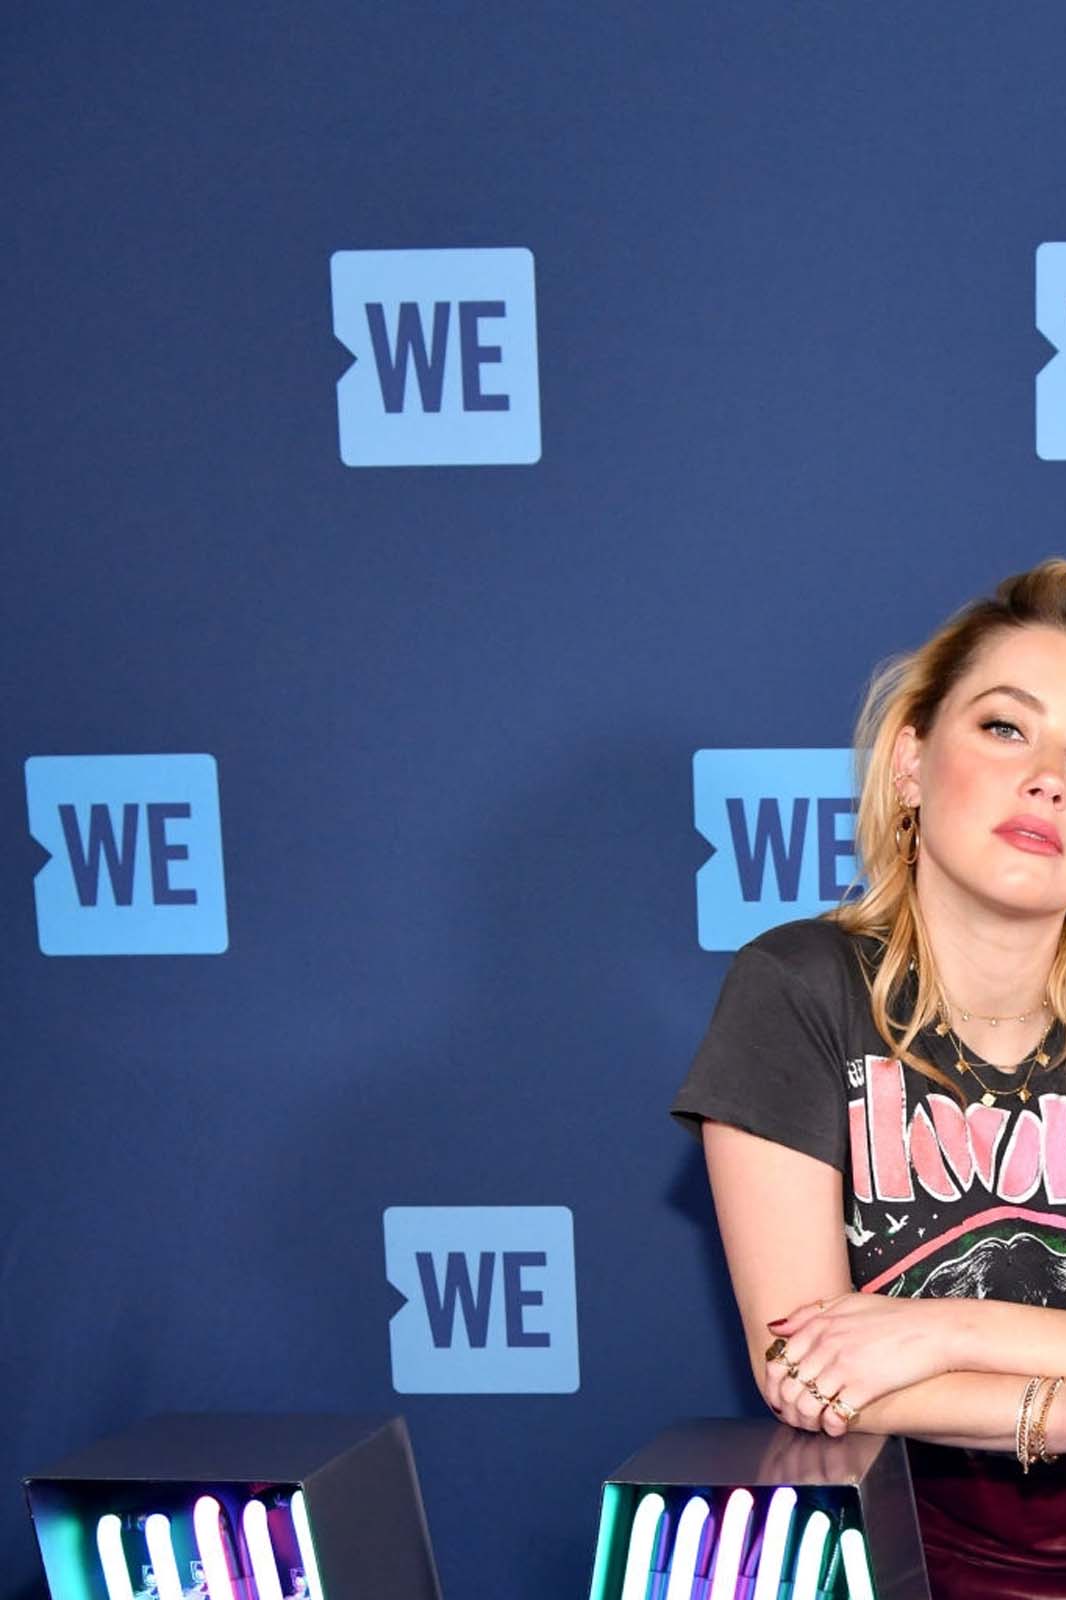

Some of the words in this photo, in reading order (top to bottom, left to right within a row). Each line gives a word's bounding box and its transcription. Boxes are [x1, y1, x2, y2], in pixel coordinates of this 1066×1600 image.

[365, 301, 510, 413] WE
[58, 803, 198, 906] WE
[725, 797, 865, 902] WE
[416, 1251, 551, 1348] WE
